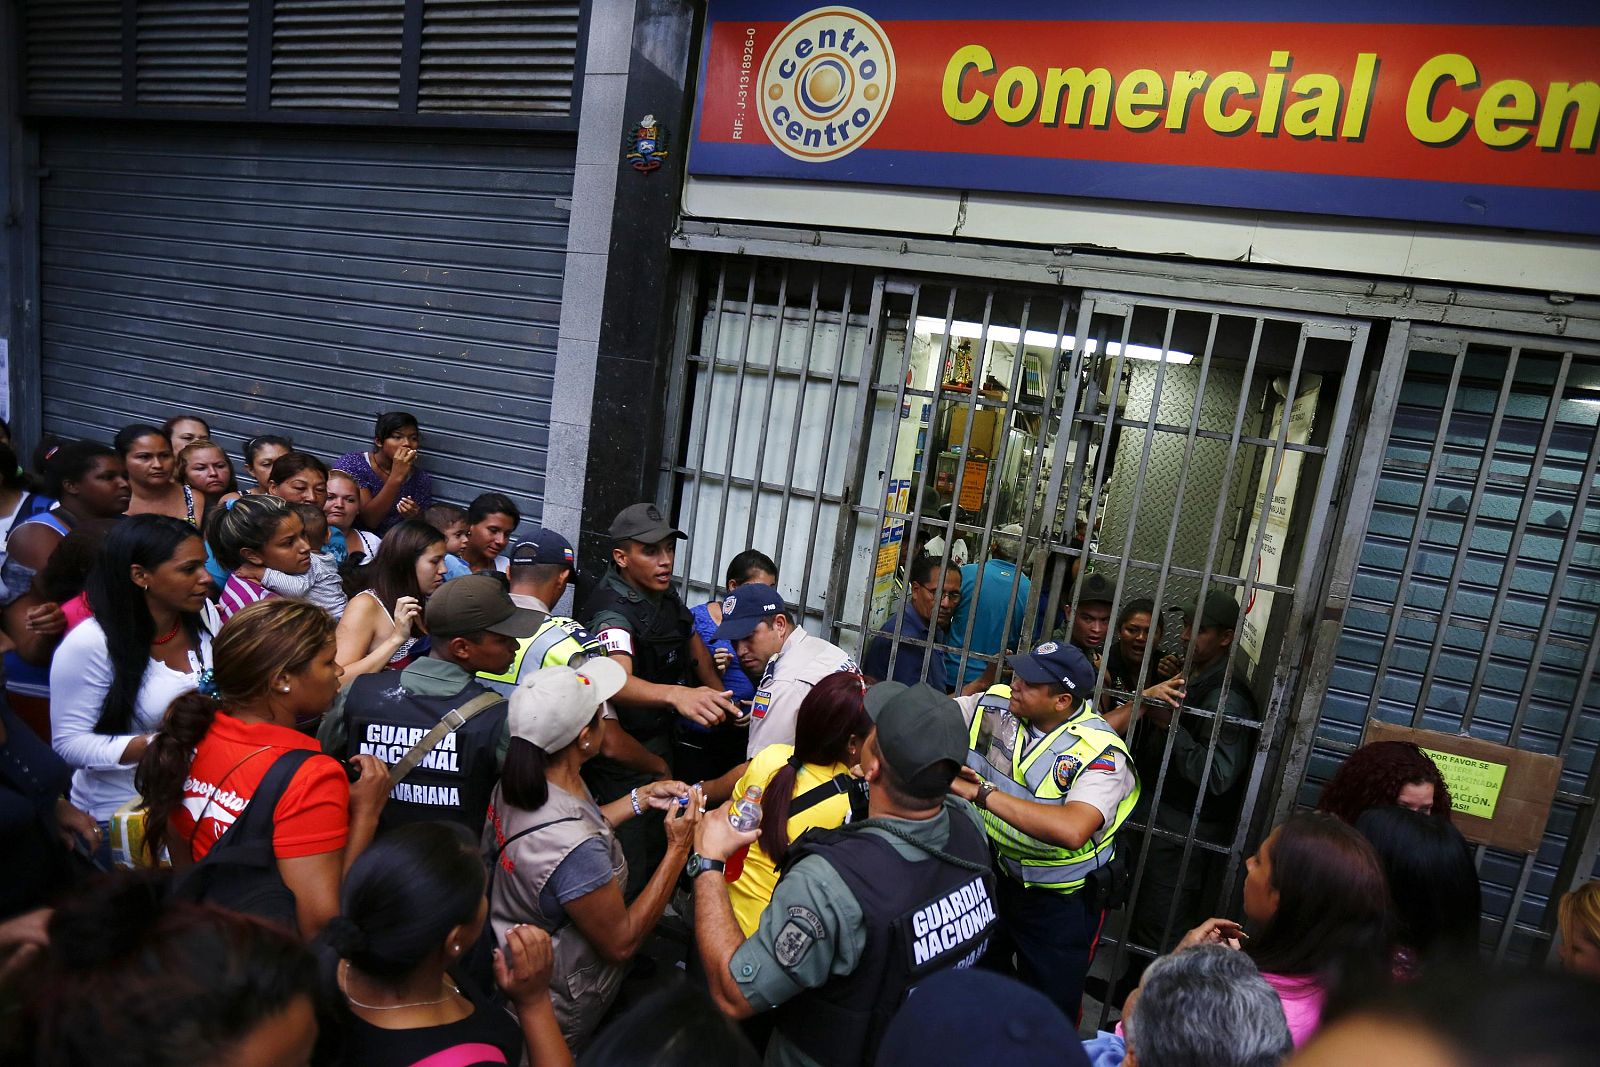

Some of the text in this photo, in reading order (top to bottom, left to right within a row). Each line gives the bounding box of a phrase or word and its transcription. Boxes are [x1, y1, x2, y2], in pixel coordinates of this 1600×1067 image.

[737, 28, 756, 109] J-31318926-0
[778, 27, 877, 81] centro
[941, 45, 1600, 151] Comercial Cen
[772, 105, 871, 148] centro
[1062, 676, 1076, 690] PNB
[359, 743, 460, 772] NACNAL
[1430, 753, 1490, 770] POR FAVOR SE
[1453, 793, 1491, 807] ACIÓN.
[912, 877, 988, 938] GUARDIA
[913, 897, 997, 966] NACIONAL
